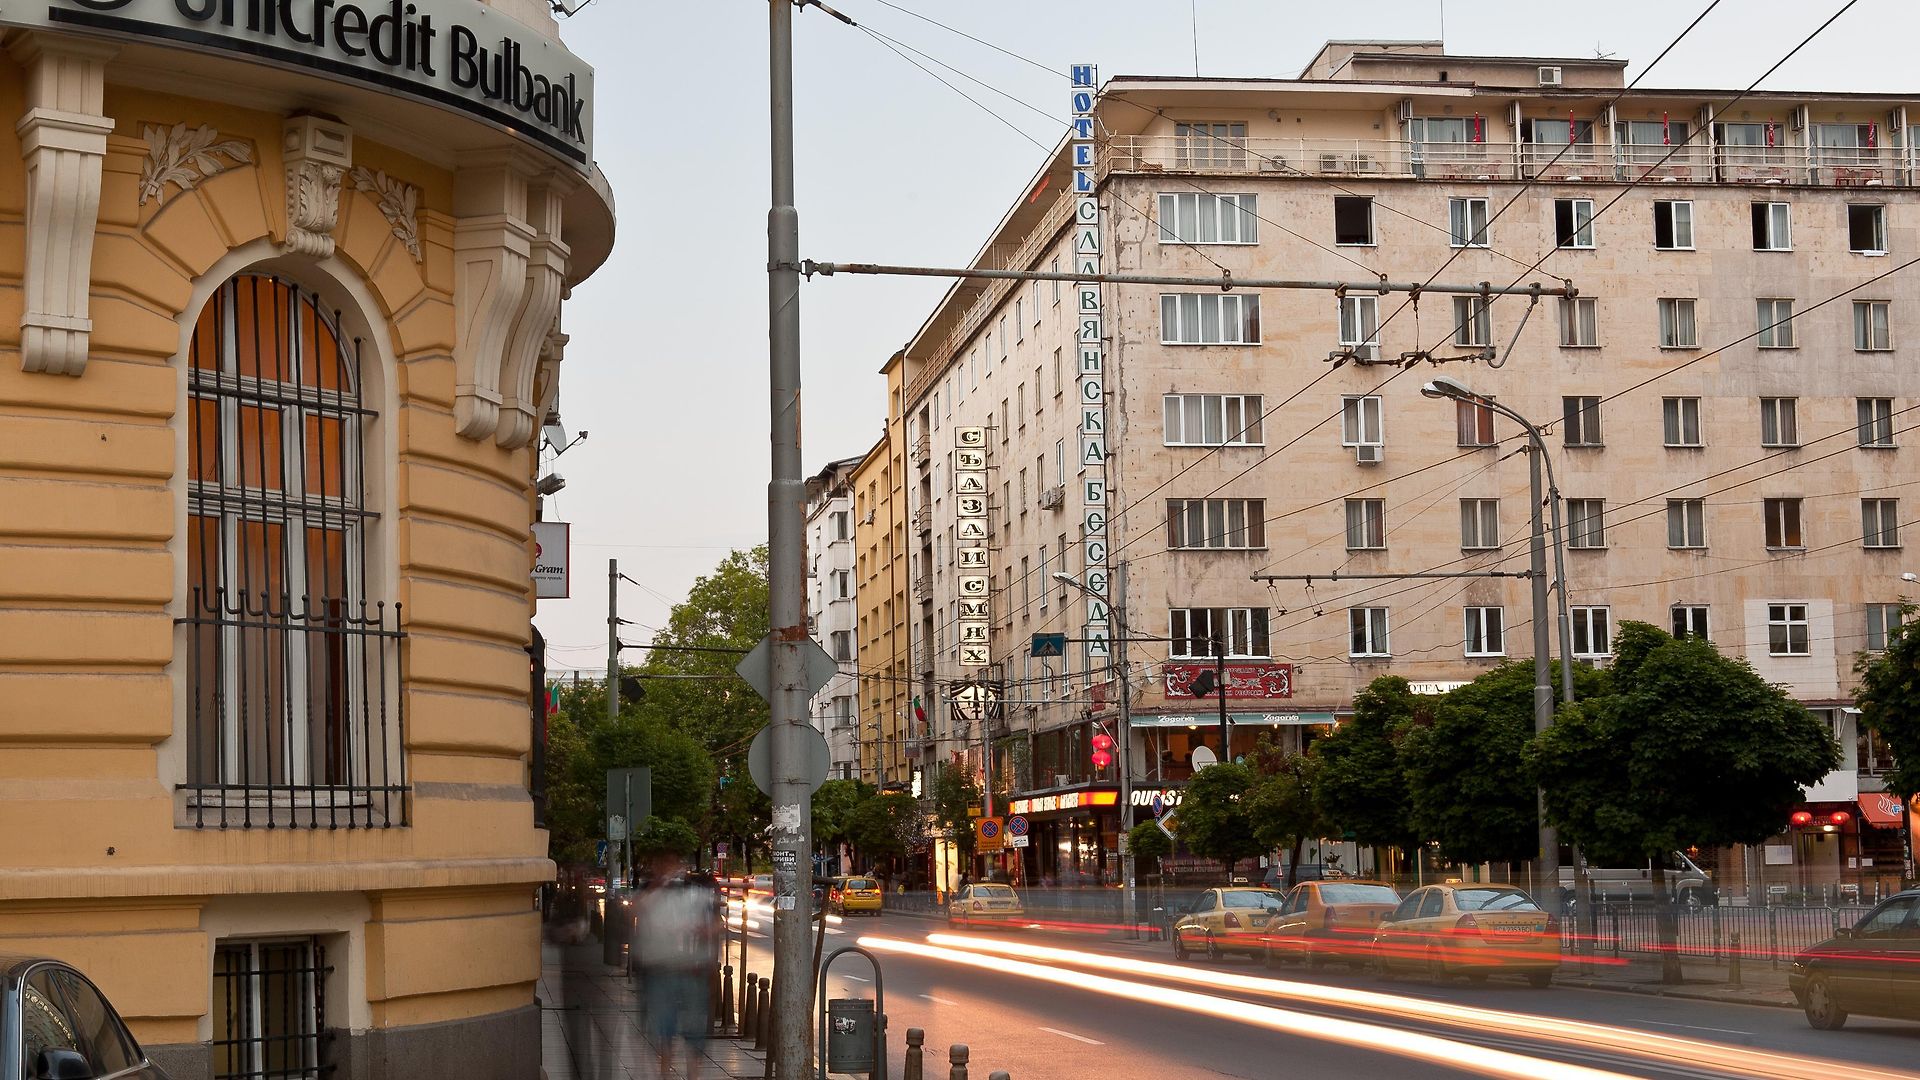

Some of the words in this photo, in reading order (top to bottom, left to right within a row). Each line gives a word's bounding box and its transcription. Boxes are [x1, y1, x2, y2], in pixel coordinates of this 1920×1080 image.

[451, 25, 585, 144] Bulbank
[1073, 66, 1092, 191] HOTEL
[1087, 482, 1108, 652] БЕСЕДА
